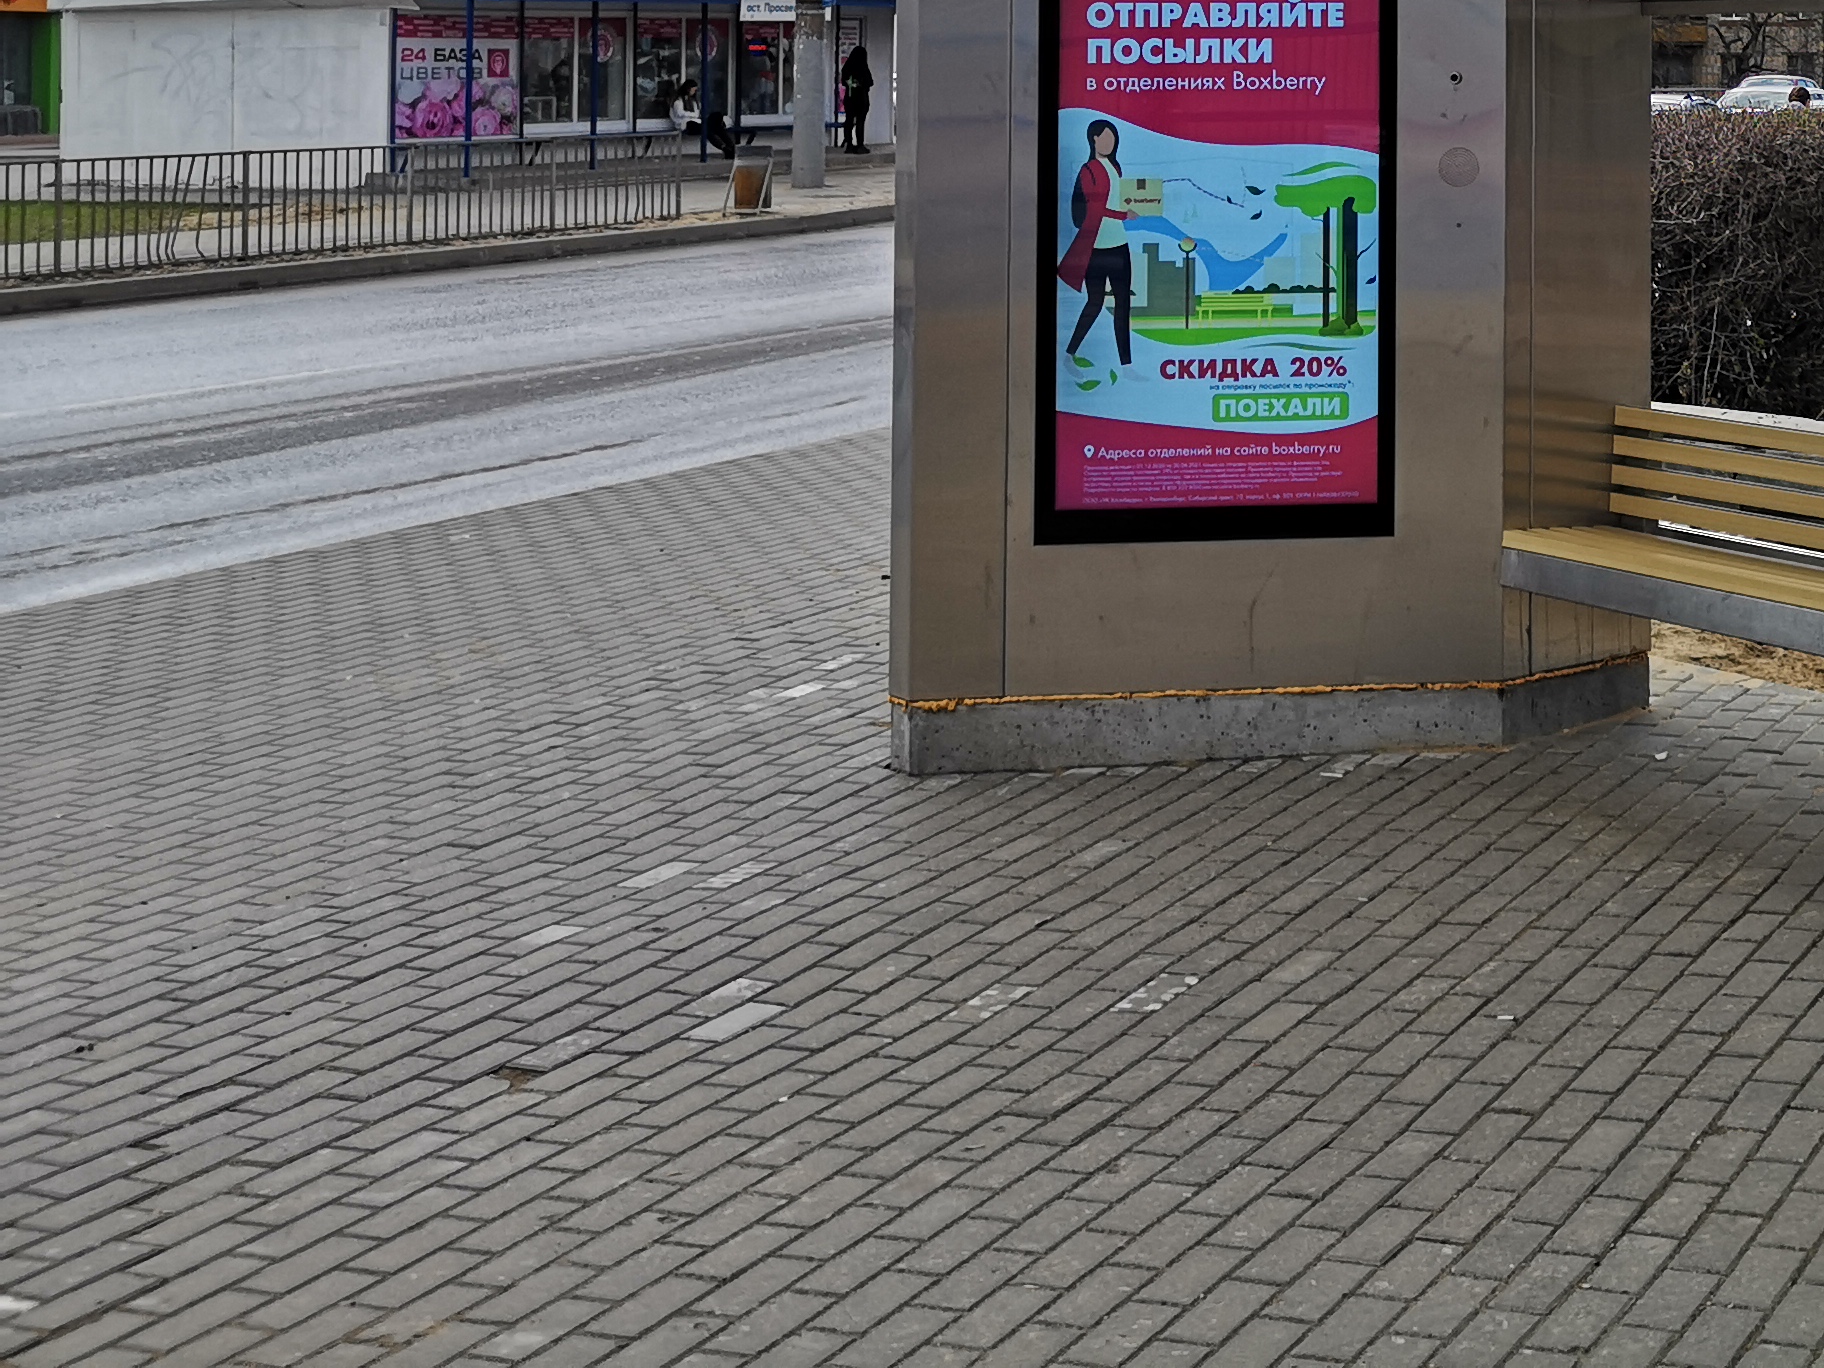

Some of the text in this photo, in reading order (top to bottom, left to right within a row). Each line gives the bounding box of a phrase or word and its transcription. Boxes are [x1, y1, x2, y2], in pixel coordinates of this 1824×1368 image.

[764, 2, 797, 14] Просве
[400, 47, 427, 62] 24
[1087, 37, 1273, 64] ПОСЫЛКИ
[1087, 69, 1327, 95] в отделениях Boxberry
[1160, 356, 1348, 382] СКИДКА 20%
[1219, 397, 1341, 418] ПОЕХАЛИ
[1098, 441, 1342, 461] Адреса отделений на сайте boxberry.ru
